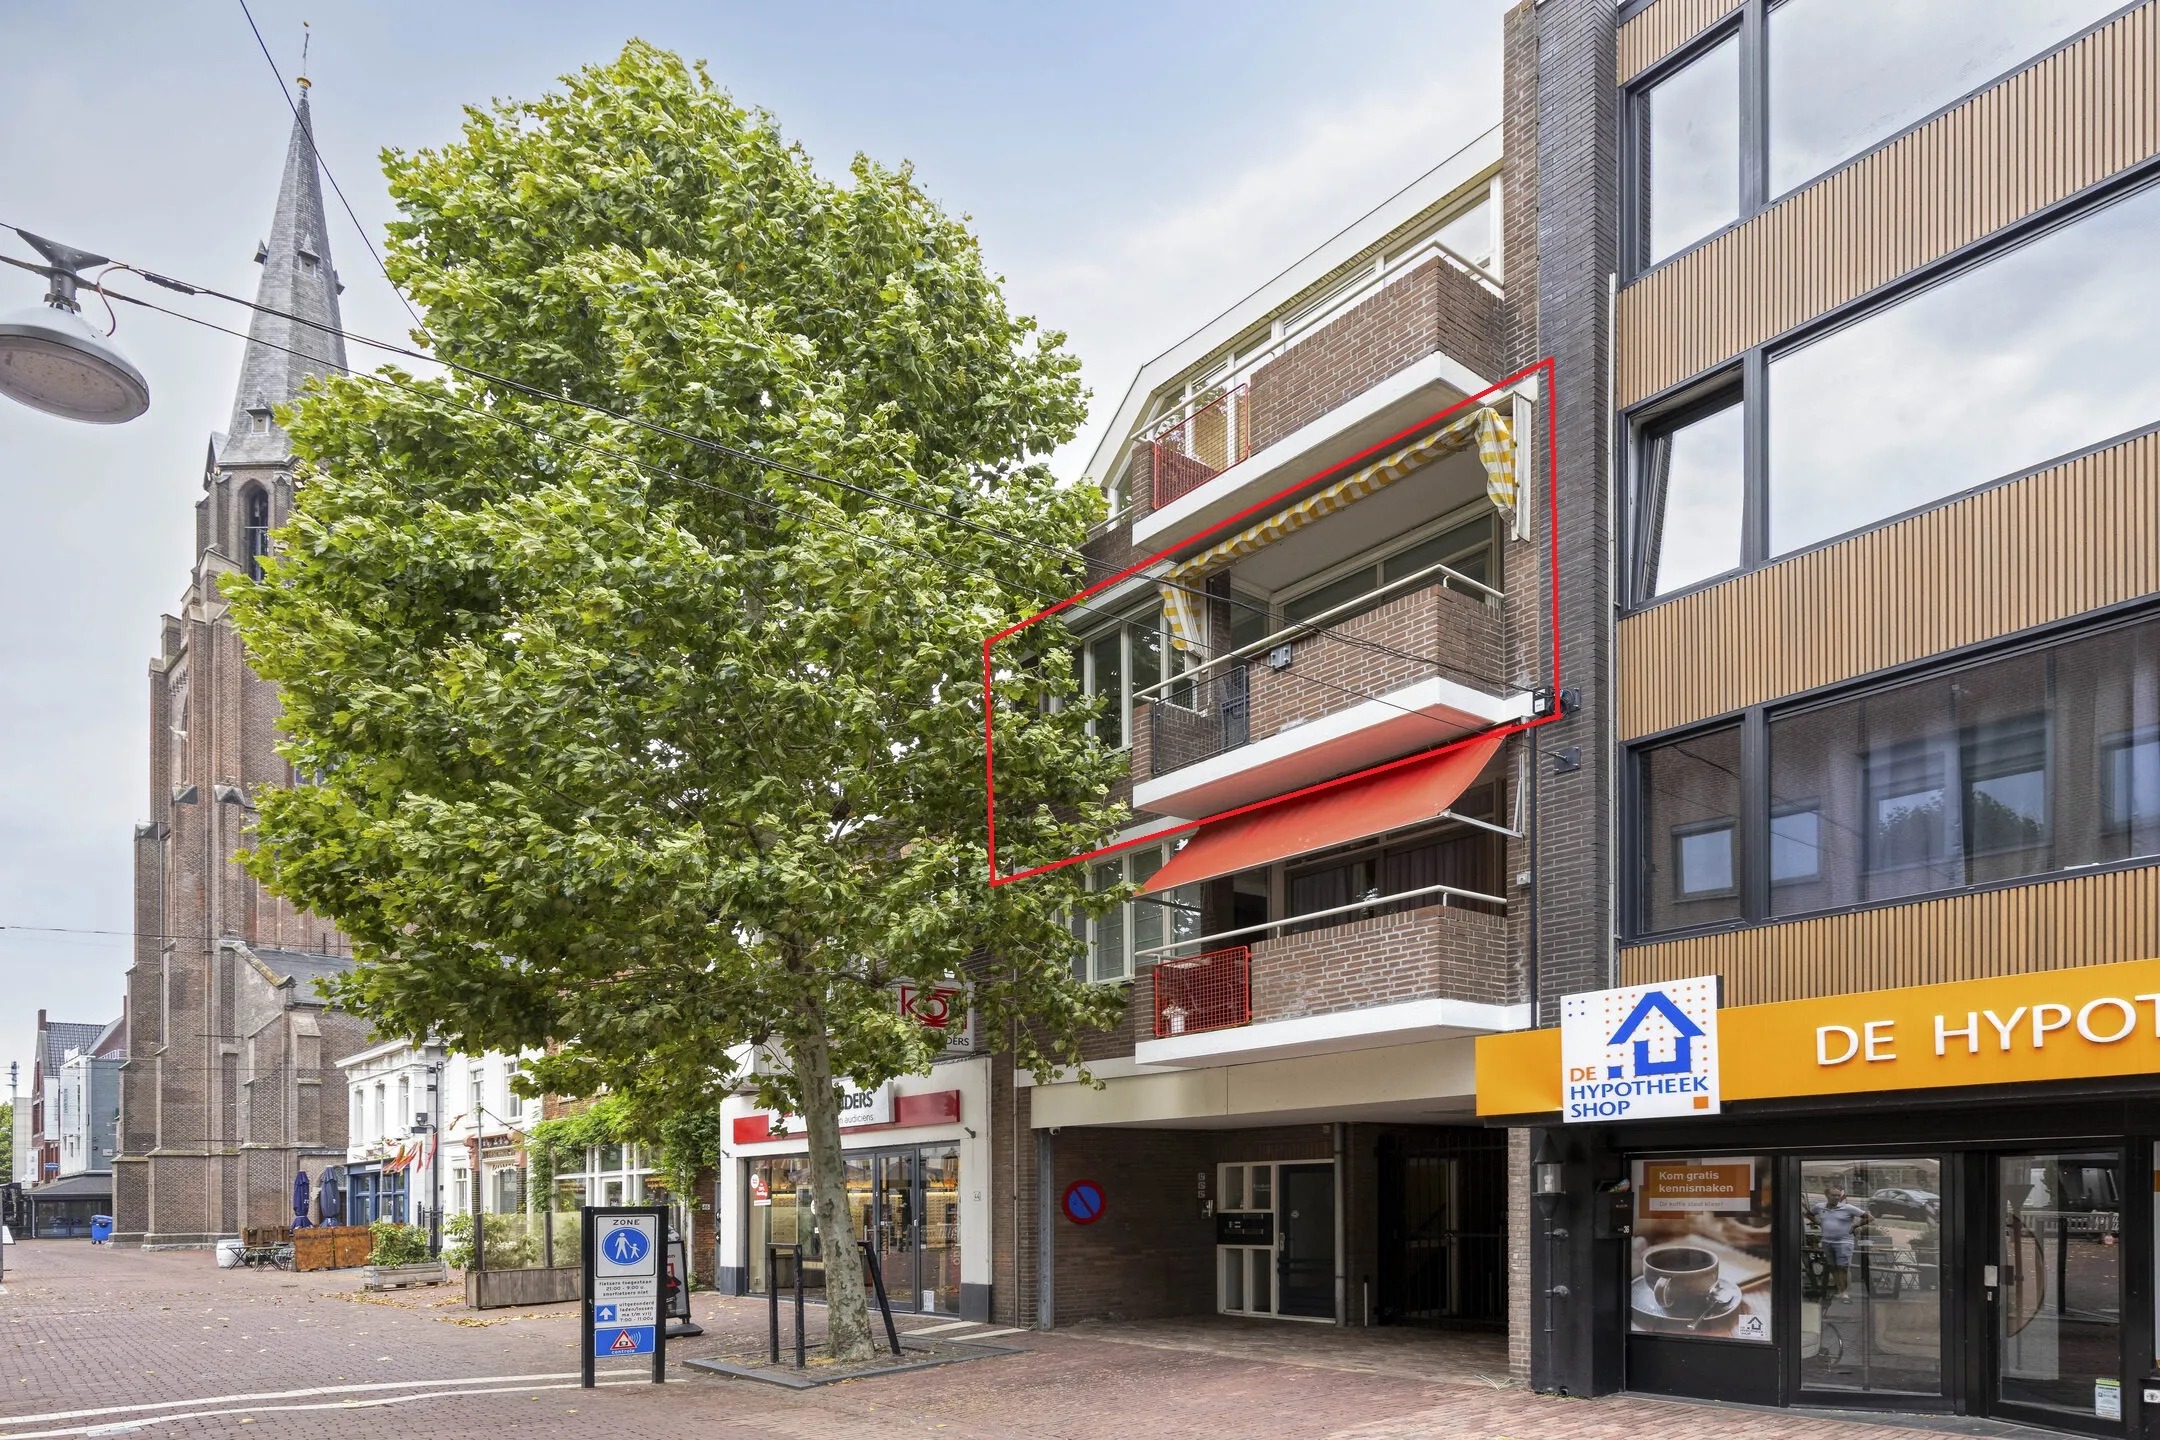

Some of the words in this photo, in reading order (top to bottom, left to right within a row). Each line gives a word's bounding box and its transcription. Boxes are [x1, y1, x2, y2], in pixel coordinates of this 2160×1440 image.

[946, 1036, 970, 1047] DERS
[1816, 1020, 1897, 1065] DE
[1570, 1066, 1597, 1082] DE
[1570, 1076, 1709, 1100] HYPOTHEEK
[843, 1090, 874, 1110] DERS
[1571, 1100, 1631, 1118] SHOP
[1659, 1171, 1684, 1181] Kom
[1686, 1170, 1720, 1182] gratis
[1659, 1183, 1734, 1193] kennismaken
